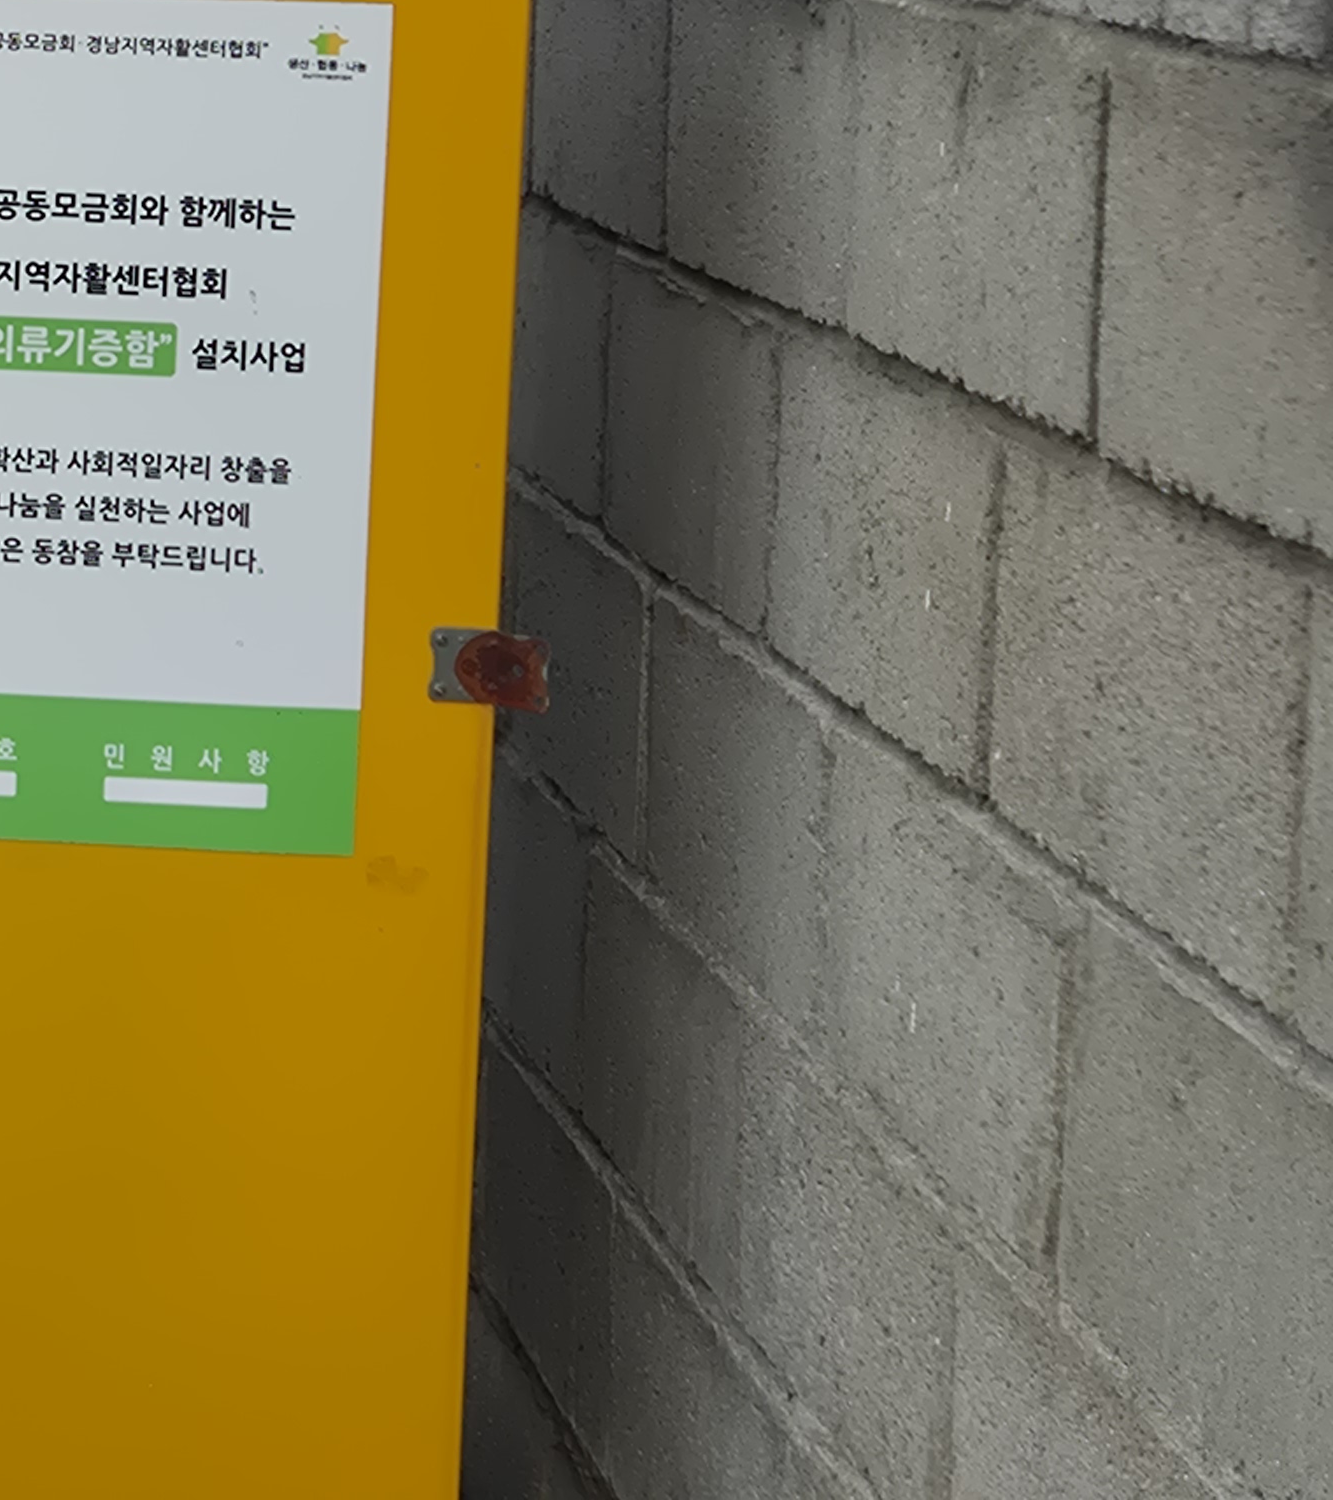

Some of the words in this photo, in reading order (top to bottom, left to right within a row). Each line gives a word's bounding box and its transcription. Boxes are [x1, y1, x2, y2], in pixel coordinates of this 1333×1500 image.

[180, 195, 296, 231] 함께하는
[191, 337, 306, 373] 설치사업
[66, 449, 211, 481] 사회적일자리
[220, 455, 291, 485] 창출을
[74, 495, 170, 524] 실천하는
[178, 499, 251, 528] 사업에
[32, 538, 103, 567] 동참을
[111, 541, 264, 575] 부탁드립니다.
